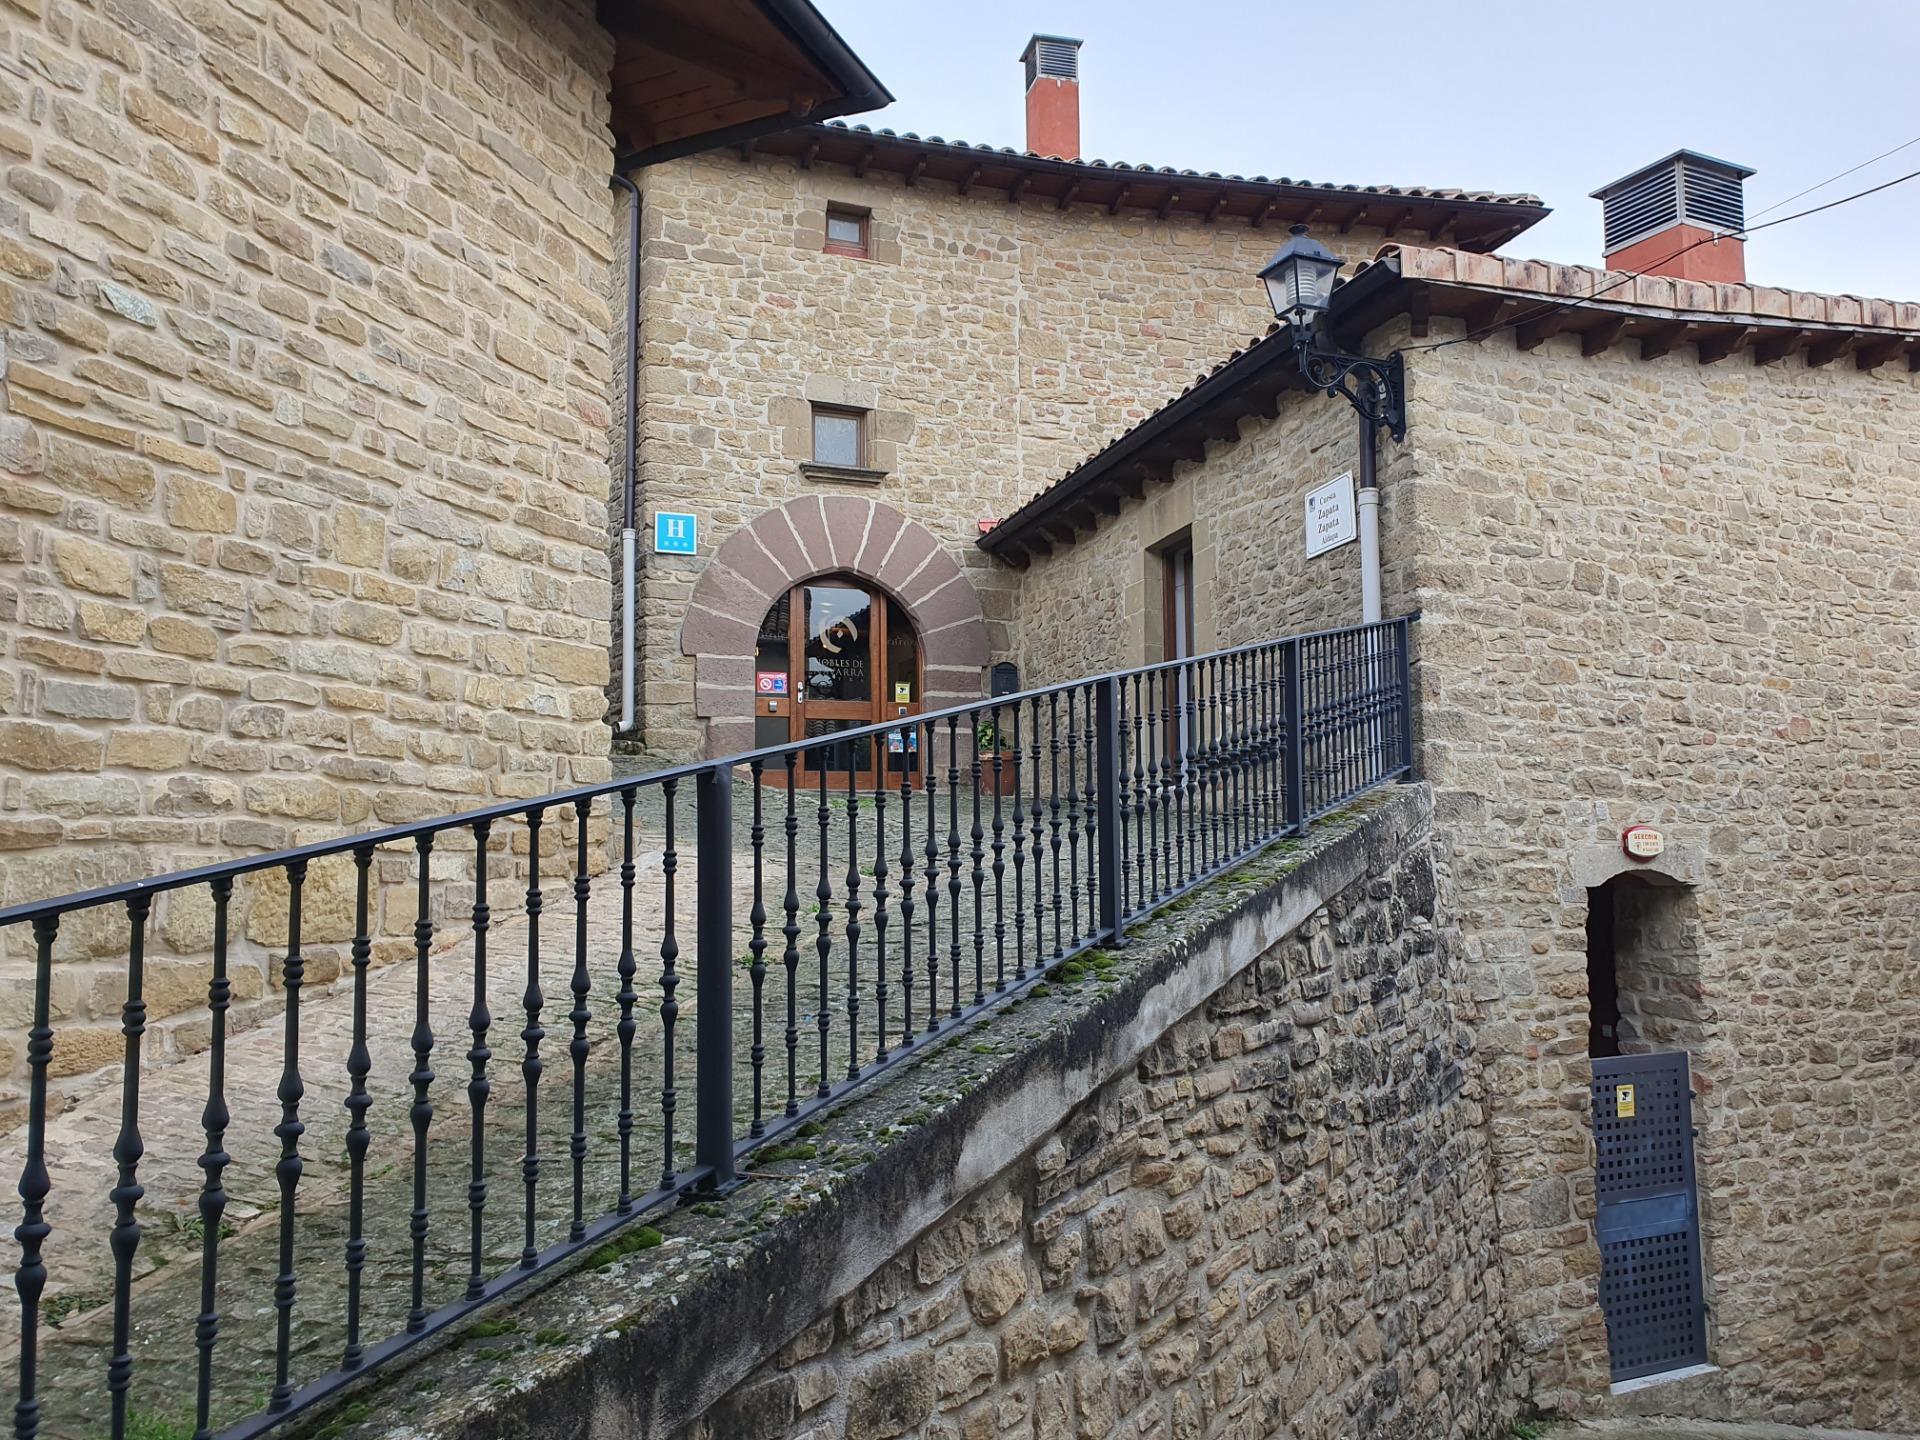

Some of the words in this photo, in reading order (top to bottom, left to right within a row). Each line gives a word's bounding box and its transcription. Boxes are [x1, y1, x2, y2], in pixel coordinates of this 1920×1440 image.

[1317, 503, 1339, 520] Zapata
[666, 518, 687, 538] H
[1317, 518, 1340, 534] Zapata
[852, 659, 864, 669] DE
